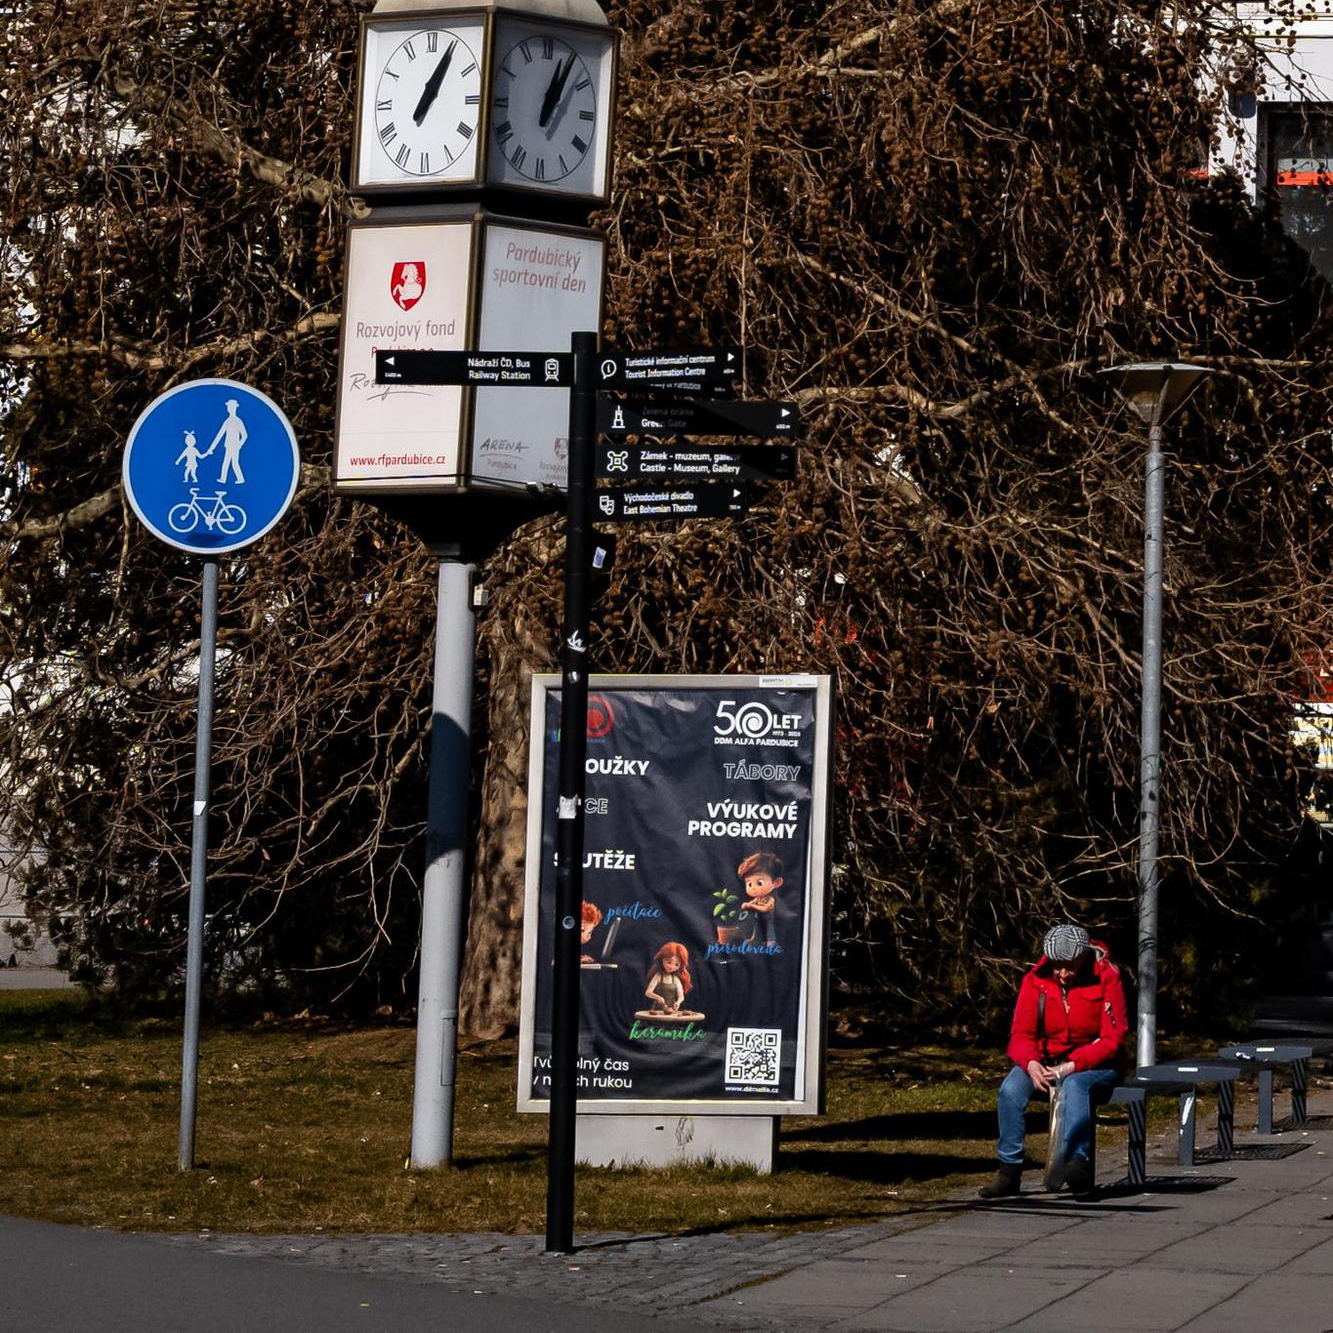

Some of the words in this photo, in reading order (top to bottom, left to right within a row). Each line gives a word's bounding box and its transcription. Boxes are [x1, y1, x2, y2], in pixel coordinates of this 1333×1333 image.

[506, 242, 581, 274] Pardubický
[493, 268, 558, 288] sportovní
[562, 274, 586, 293] den
[356, 320, 421, 342] Rozvojový
[426, 319, 455, 336] fond
[467, 357, 499, 368] Nádraží
[500, 356, 514, 369] ČD,
[516, 359, 530, 368] Bus
[625, 357, 654, 367] Turistické
[655, 355, 688, 365] informační
[689, 355, 715, 364] centrum
[469, 370, 499, 382] Railway
[501, 370, 531, 380] Station
[625, 370, 646, 379] Tourist
[647, 368, 684, 378] Information
[684, 368, 706, 376] Centre
[480, 438, 525, 454] ARENA
[350, 453, 446, 467] www.rfpardubice.cz
[640, 450, 668, 460] Zámek
[675, 453, 712, 463] muzeum,
[640, 463, 666, 472] Castle
[673, 464, 711, 474] Museum,
[712, 464, 741, 475] Gallery
[670, 491, 694, 500] divadlo
[623, 505, 638, 514] East
[639, 505, 671, 514] Bohemian
[672, 504, 698, 512] Theatre
[713, 700, 773, 738] 50
[773, 714, 802, 729] LET
[714, 737, 733, 745] DDM
[734, 737, 755, 746] ALFA
[756, 738, 799, 747] PARDUBICE
[723, 759, 801, 781] TÁBORY
[707, 798, 798, 821] VÝUKOVÉ
[688, 820, 798, 839] PROGRAMY
[628, 1020, 706, 1040] keramika
[604, 1058, 630, 1071] čas
[593, 1075, 633, 1088] rukou
